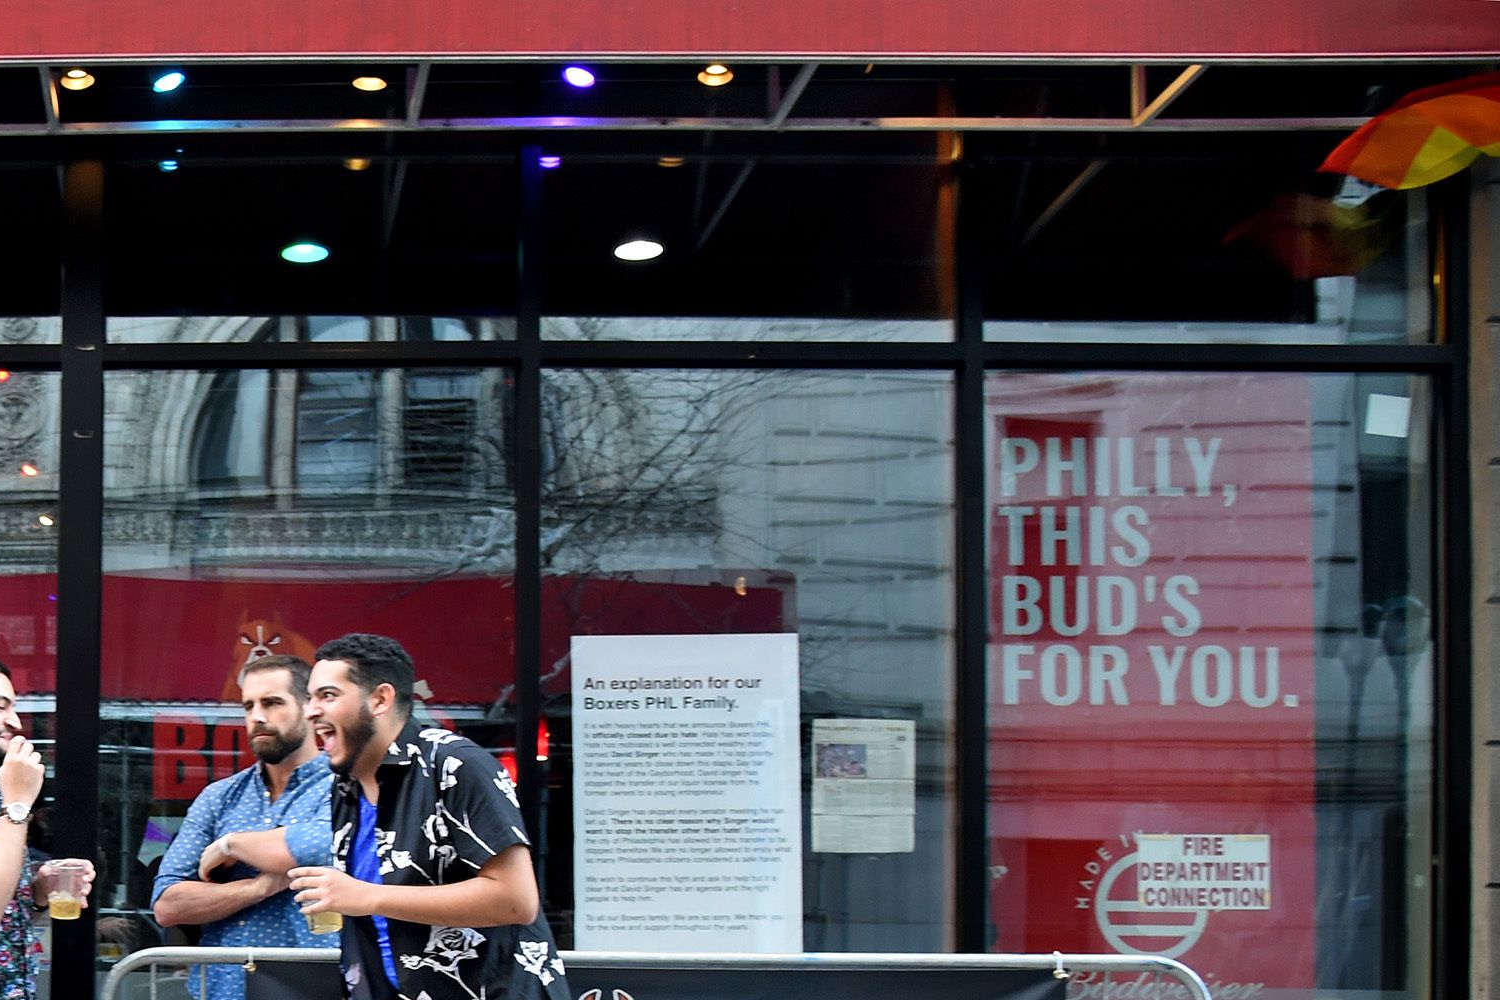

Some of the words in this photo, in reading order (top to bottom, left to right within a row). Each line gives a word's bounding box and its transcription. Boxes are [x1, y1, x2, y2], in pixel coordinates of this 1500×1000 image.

[1000, 437, 1238, 507] PHILLY,
[999, 505, 1150, 567] THIS
[1003, 575, 1201, 637] BUD'S
[584, 678, 605, 690] An
[611, 677, 703, 692] explanation
[708, 677, 730, 689] for
[735, 679, 761, 689] our
[1003, 645, 1130, 706] FOR
[1148, 645, 1299, 708] YOU.
[584, 697, 639, 709] Boxers
[645, 697, 678, 709] PHL
[683, 697, 739, 712] Family.
[1184, 837, 1223, 855] FIRE
[1075, 847, 1112, 909] MADE
[1140, 862, 1267, 881] DEPARTMENT
[1144, 888, 1265, 907] CONNECTION
